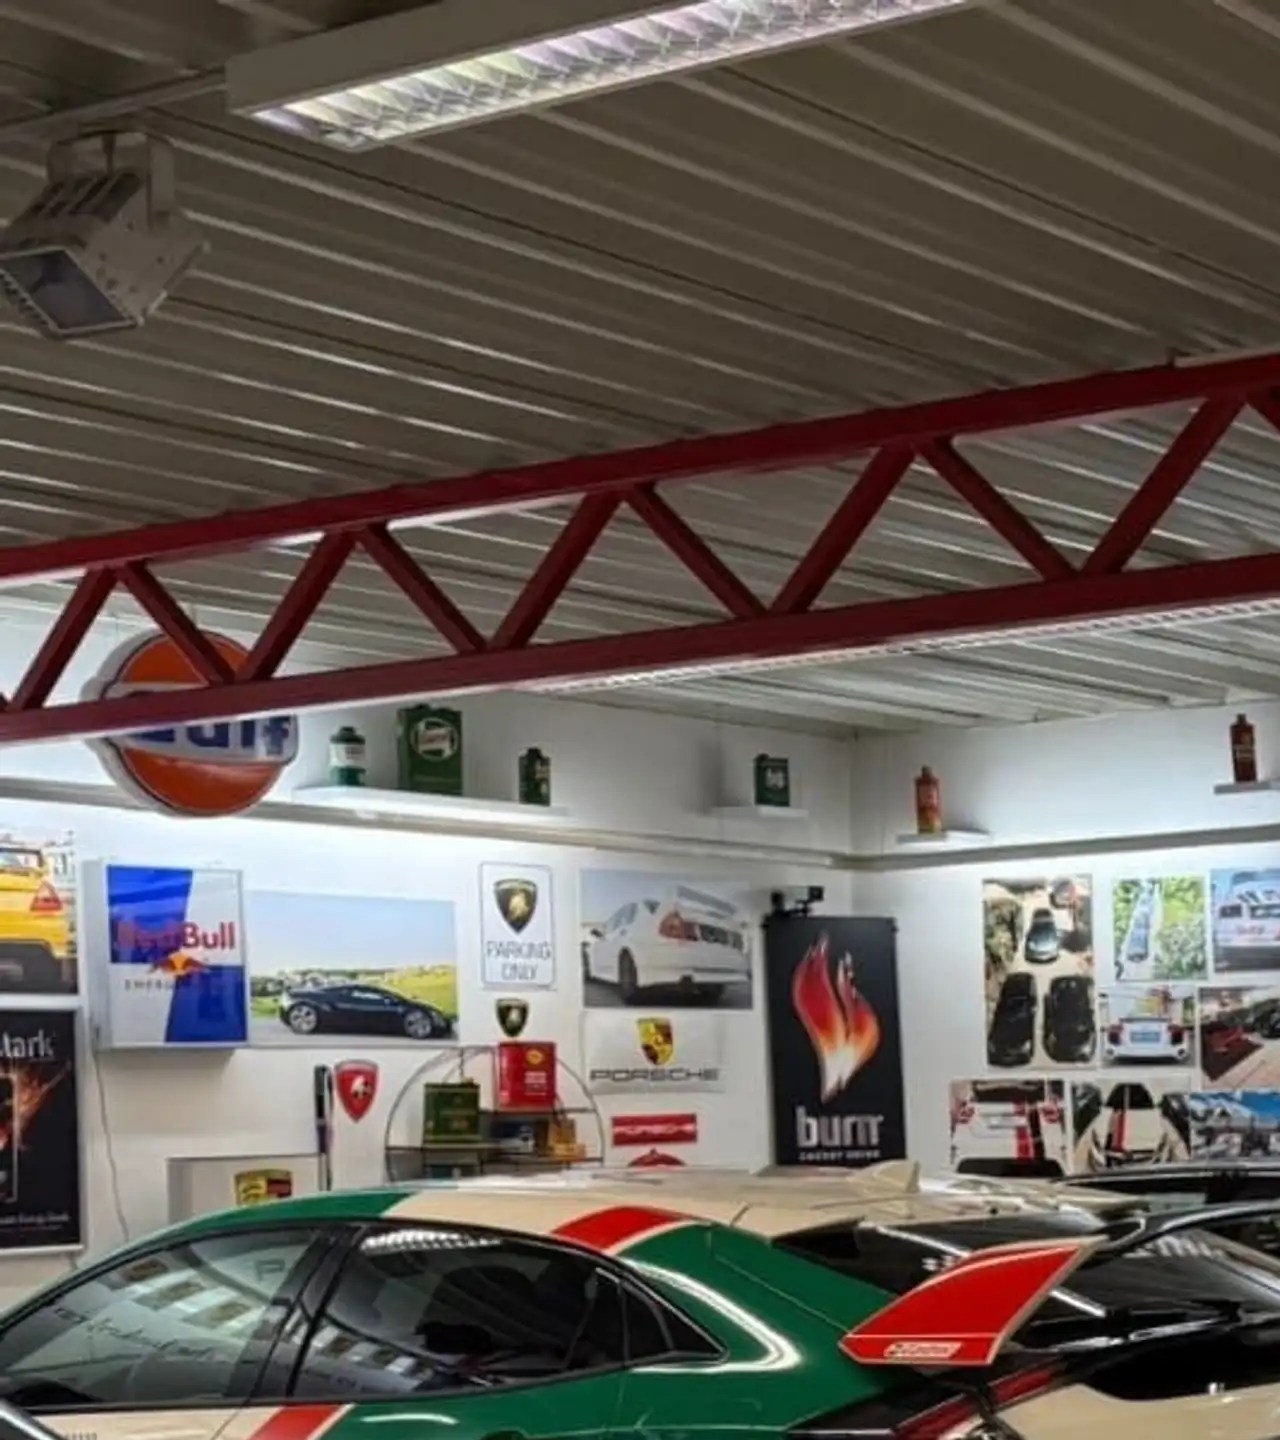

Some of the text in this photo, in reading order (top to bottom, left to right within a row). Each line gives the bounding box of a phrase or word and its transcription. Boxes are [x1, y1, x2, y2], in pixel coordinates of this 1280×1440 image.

[486, 940, 552, 960] PARKING
[590, 1067, 719, 1082] PORSCHE
[796, 1105, 884, 1148] burn
